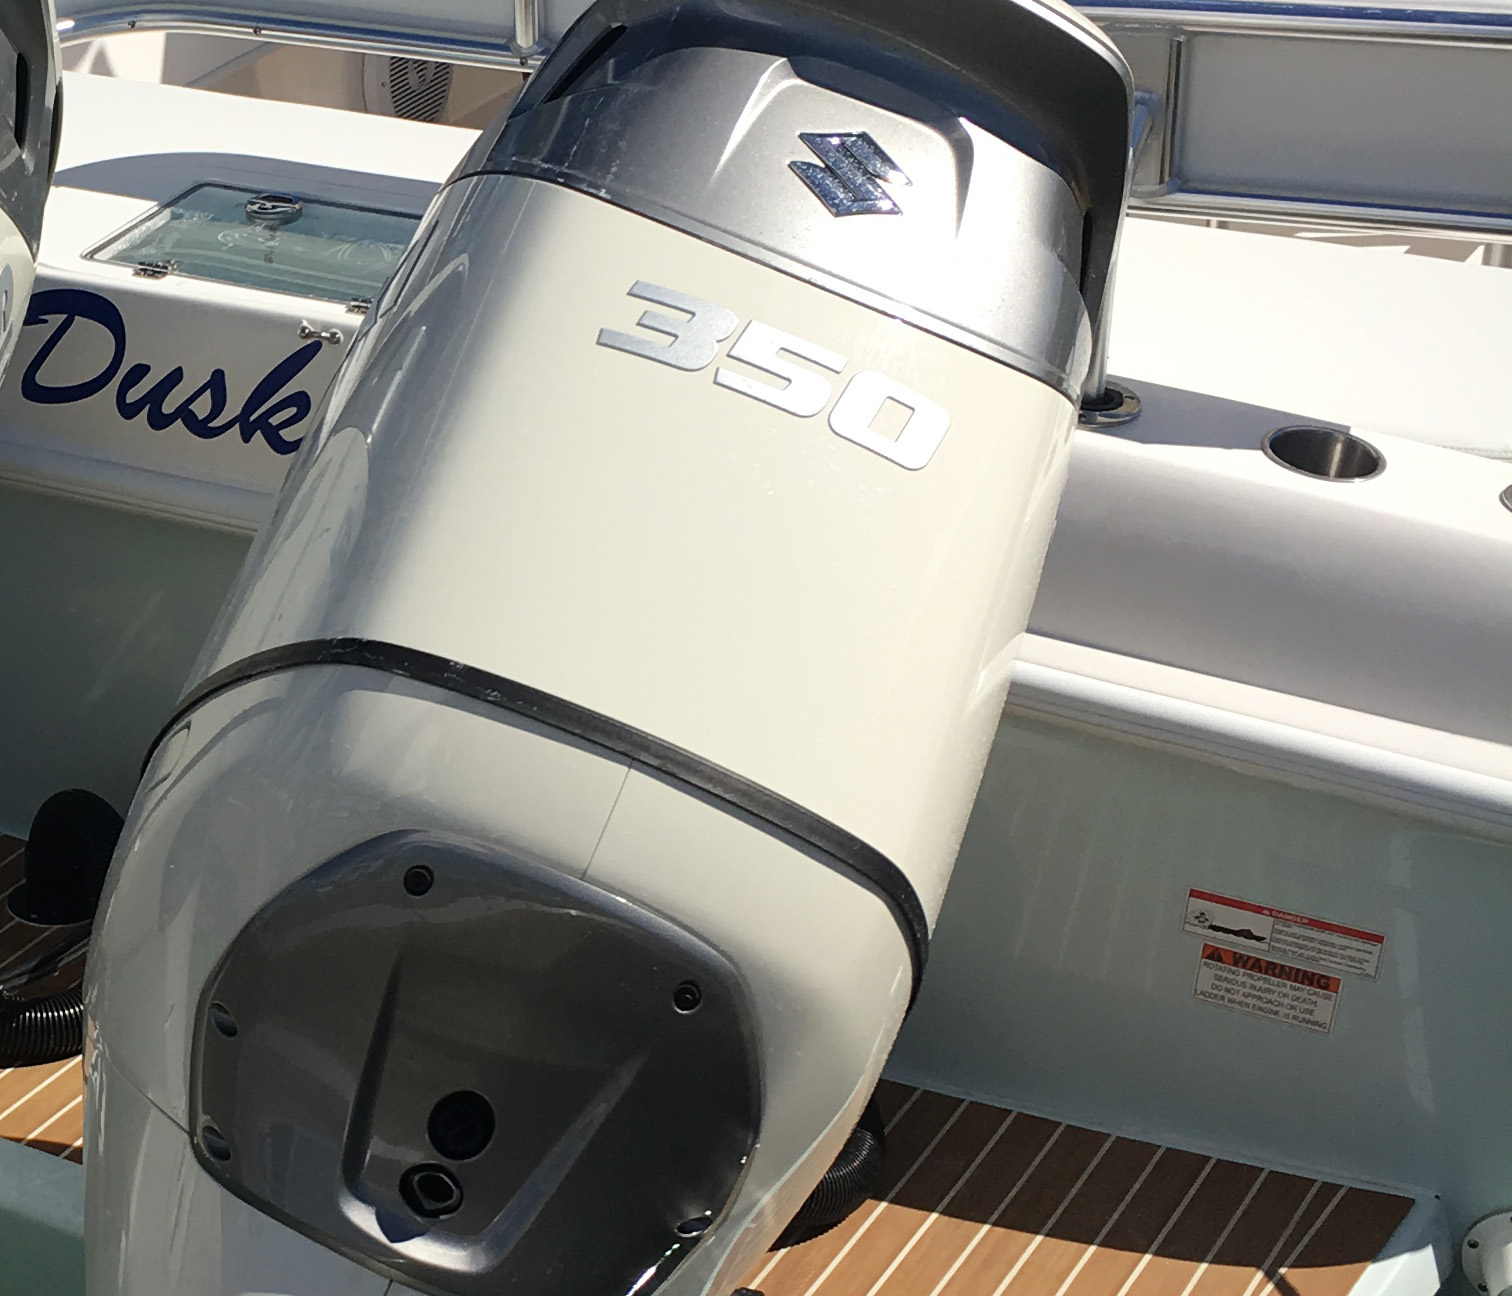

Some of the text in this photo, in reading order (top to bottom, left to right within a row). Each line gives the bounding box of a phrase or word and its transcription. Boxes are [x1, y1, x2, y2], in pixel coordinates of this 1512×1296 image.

[23, 289, 323, 456] Dusk
[595, 279, 951, 471] 350
[1203, 960, 1241, 977] ROTATING
[1242, 969, 1288, 989] PROPELLER
[1307, 988, 1334, 1001] CAUSE
[1211, 983, 1223, 992] DO
[1224, 986, 1240, 996] NOT
[1231, 950, 1330, 990] WARNING
[1195, 989, 1226, 1003] LADDER
[1227, 996, 1251, 1010] WHEN
[1291, 993, 1318, 1007] DEATH
